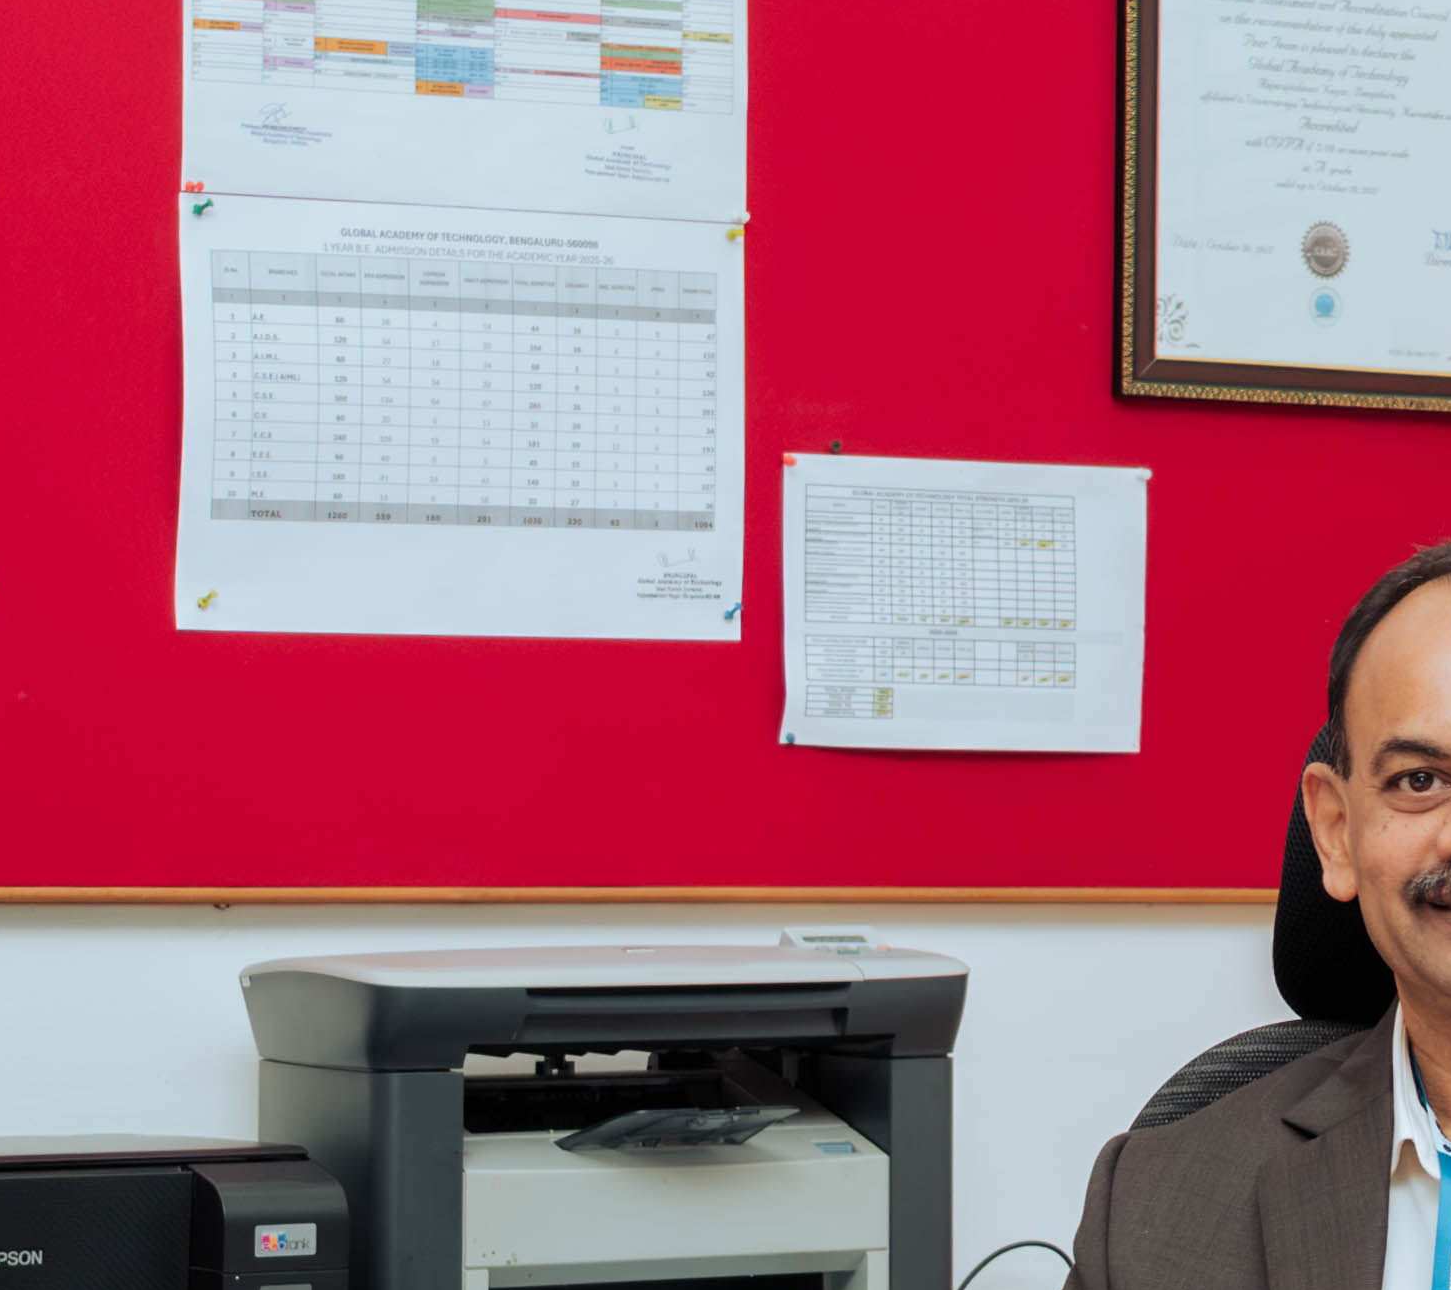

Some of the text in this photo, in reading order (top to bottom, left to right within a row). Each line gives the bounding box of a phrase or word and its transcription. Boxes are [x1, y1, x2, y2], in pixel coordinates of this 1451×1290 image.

[340, 228, 378, 239] GLOBAL
[379, 230, 425, 241] ACADEMY
[426, 232, 440, 242] OF
[375, 246, 428, 257] ADMISSION
[250, 510, 282, 519] TOTAL
